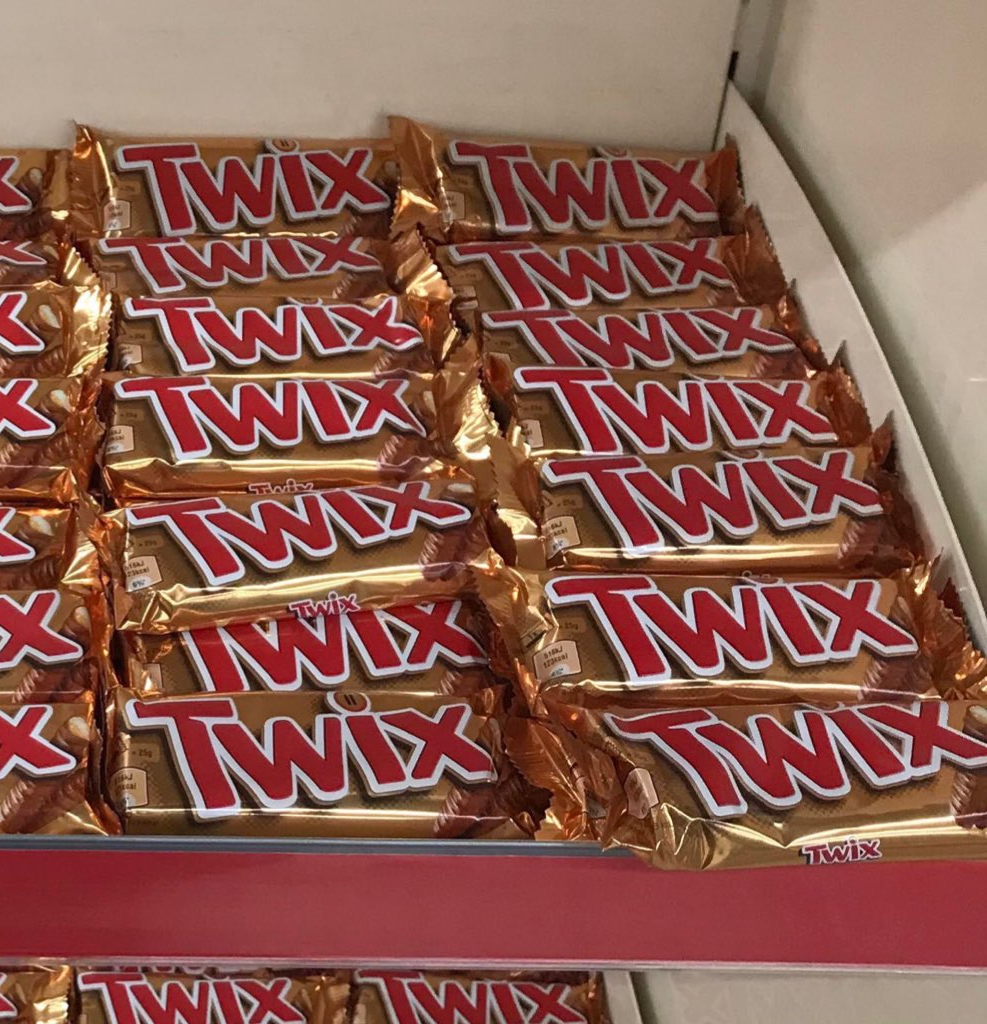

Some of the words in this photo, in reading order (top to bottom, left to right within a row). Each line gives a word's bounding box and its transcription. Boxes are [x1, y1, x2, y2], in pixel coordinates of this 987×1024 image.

[115, 139, 391, 237] Twix
[448, 140, 719, 235] Twix
[98, 235, 383, 295] Twix
[449, 237, 737, 310] Twix
[124, 296, 425, 375] Twix
[482, 307, 797, 369] Twix
[115, 376, 427, 462] Twix
[514, 366, 839, 456] Twix
[125, 480, 472, 587] Twix
[542, 449, 883, 558] Twix
[288, 592, 361, 619] Twix
[544, 574, 919, 688] Twix
[125, 690, 497, 823] Twix
[604, 699, 987, 818] Twix
[801, 836, 883, 866] Twix
[78, 971, 306, 1024] Twix
[354, 970, 588, 1024] Twix
